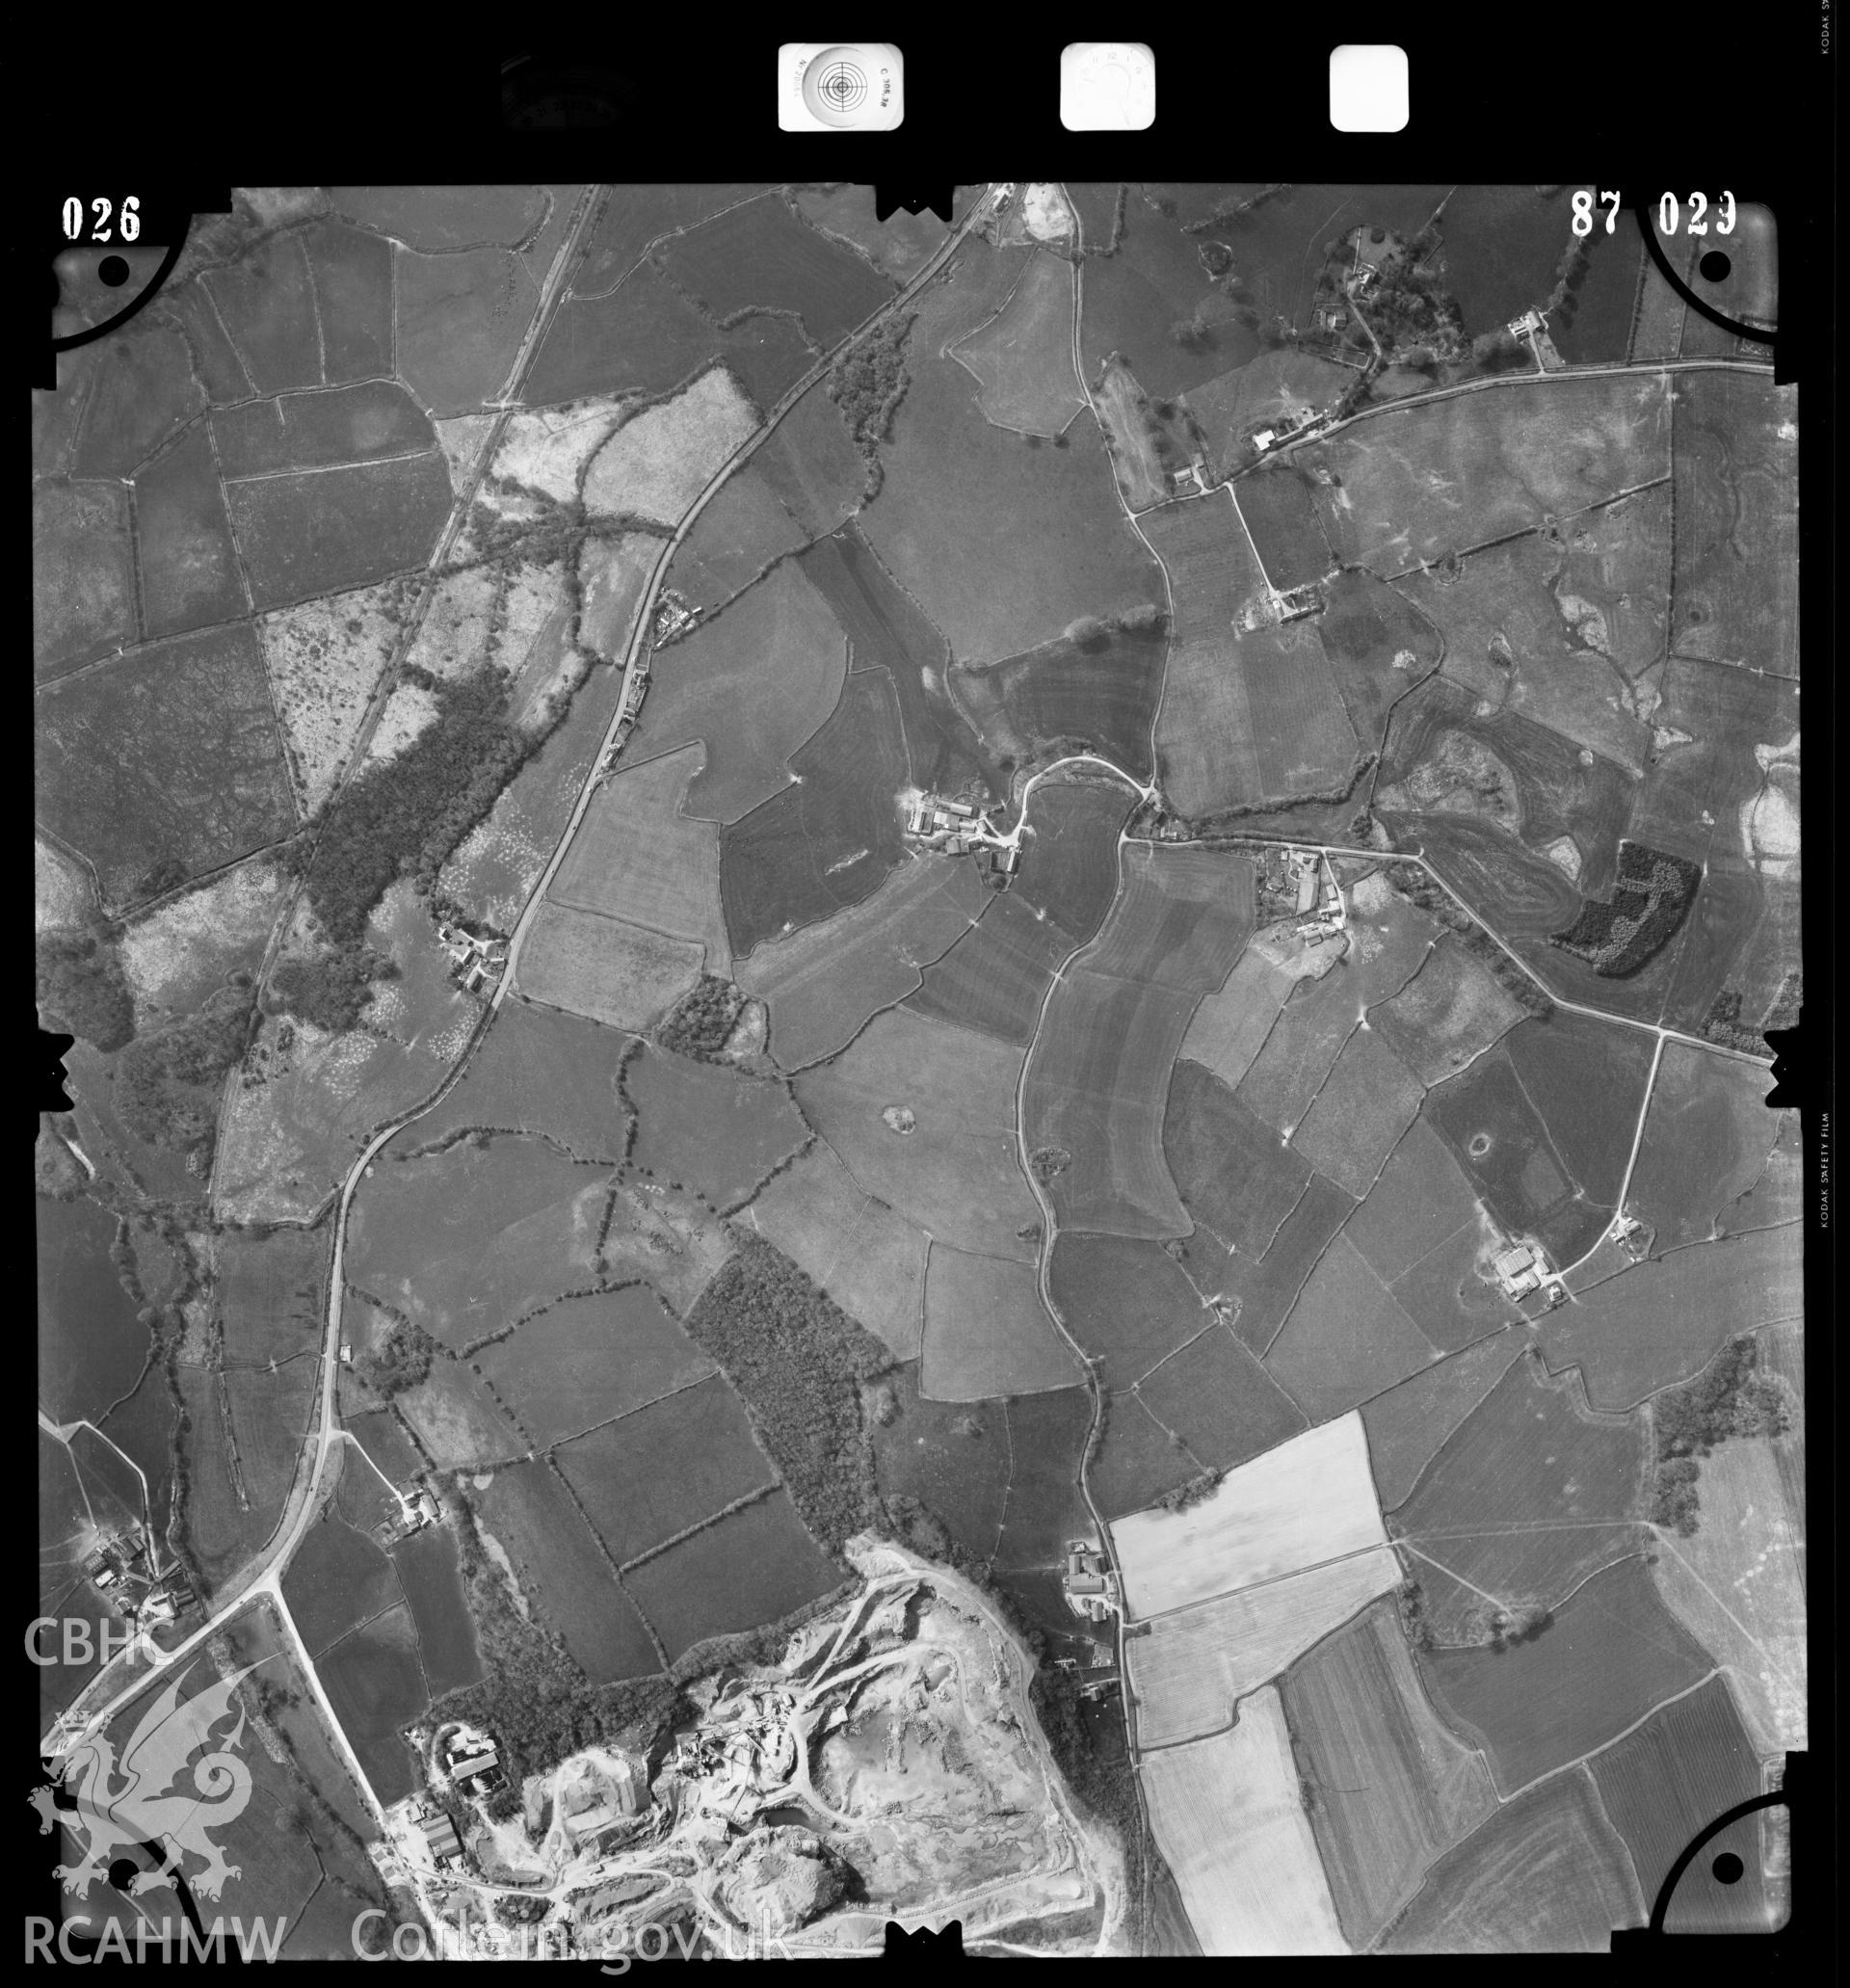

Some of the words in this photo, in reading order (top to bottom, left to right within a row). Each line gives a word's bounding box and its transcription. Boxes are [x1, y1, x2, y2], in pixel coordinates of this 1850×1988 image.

[1821, 15, 1830, 55] KODAK
[62, 196, 141, 242] 026
[1572, 190, 1621, 237] 87
[1820, 1143, 1829, 1183] SAFETY
[1820, 1189, 1829, 1228] KODAK
